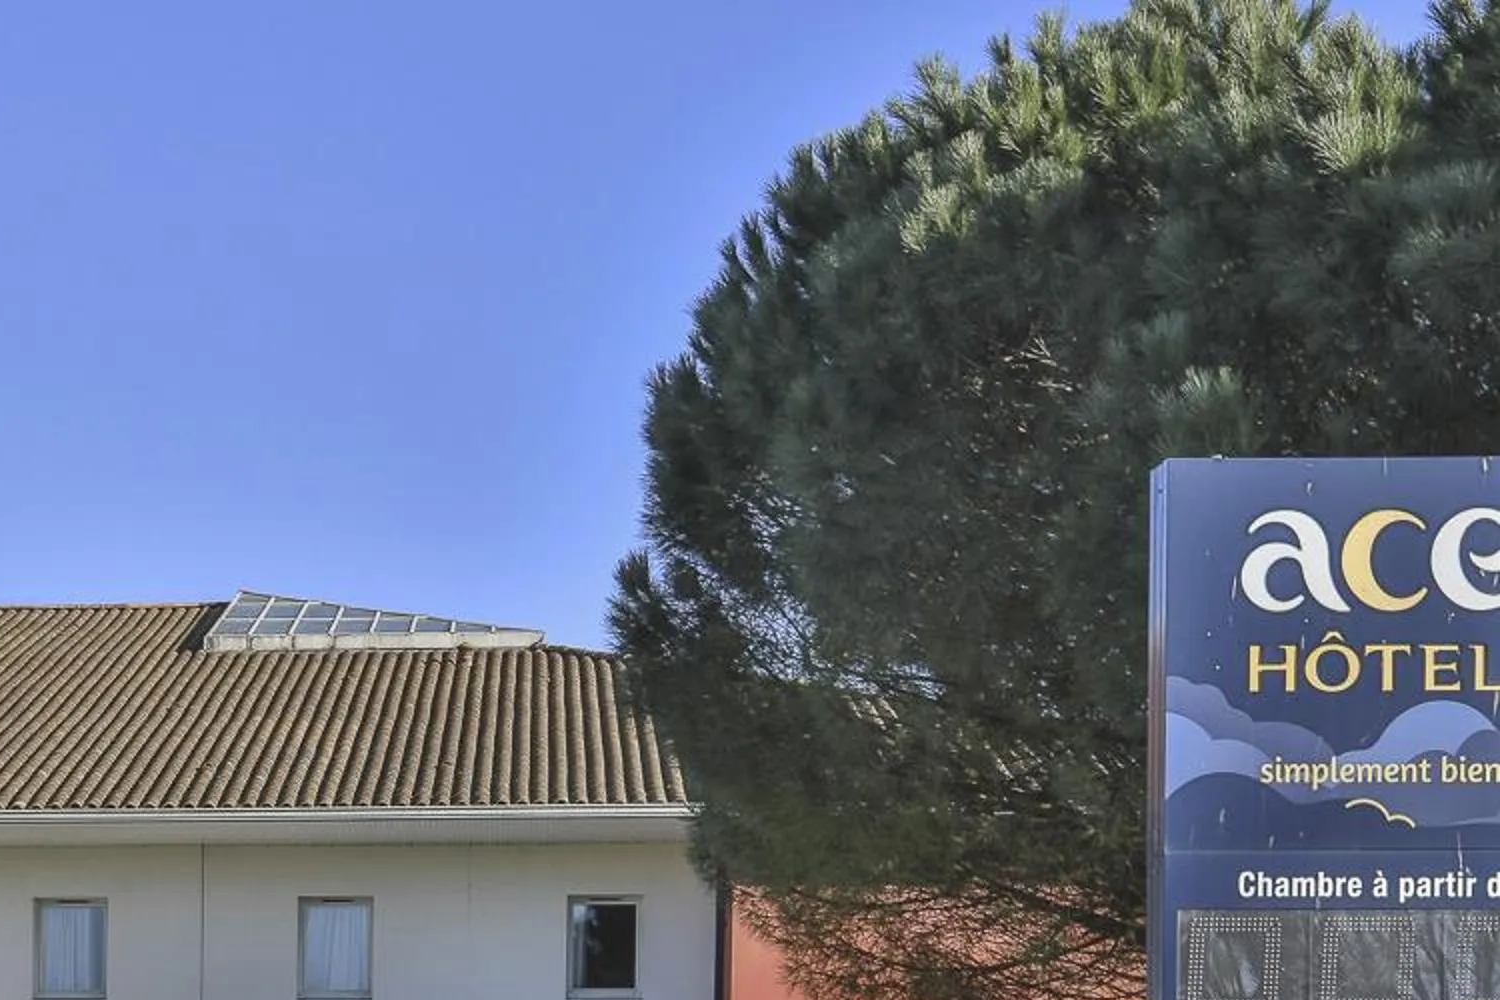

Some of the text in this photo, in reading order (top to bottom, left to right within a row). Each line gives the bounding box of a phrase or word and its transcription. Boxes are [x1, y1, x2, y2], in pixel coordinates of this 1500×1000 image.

[1240, 508, 1500, 613] ace
[1249, 631, 1500, 693] HÔTEL
[1260, 755, 1500, 788] simplement bien
[1238, 871, 1362, 898] Chambre
[1373, 870, 1388, 898] à
[1399, 872, 1477, 903] partir
